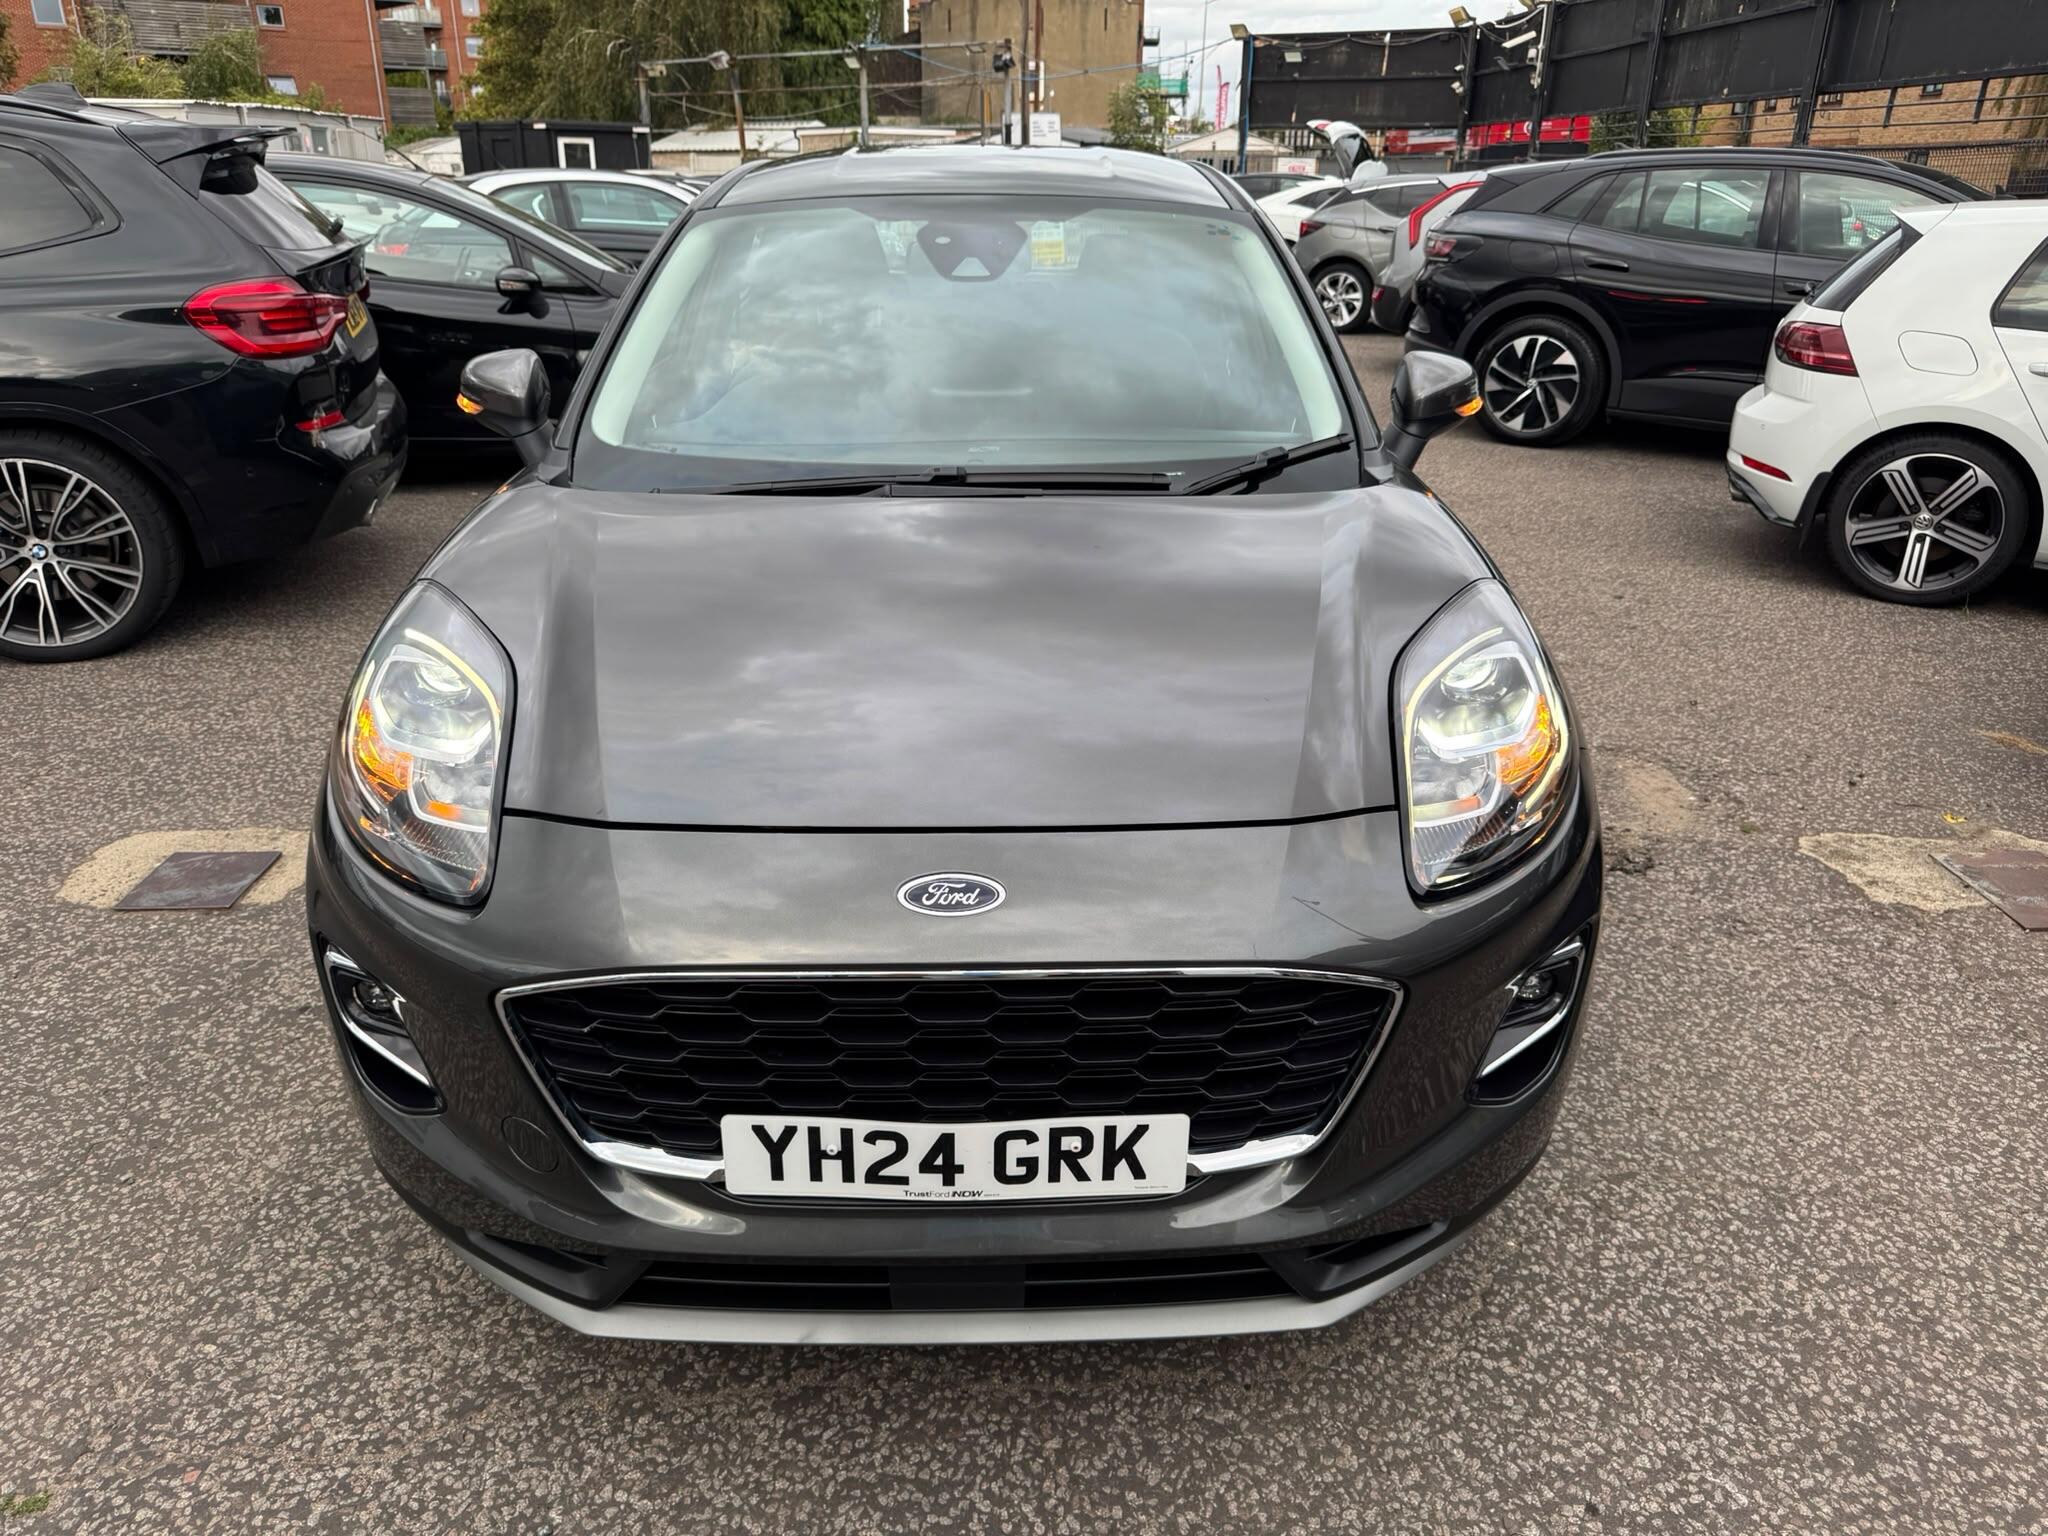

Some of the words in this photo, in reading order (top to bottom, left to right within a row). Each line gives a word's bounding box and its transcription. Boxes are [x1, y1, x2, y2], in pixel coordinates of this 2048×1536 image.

[921, 882, 980, 906] Ford
[751, 1124, 965, 1187] YH24
[993, 1124, 1150, 1185] GRK
[903, 1189, 950, 1198] TrustFord
[951, 1189, 984, 1198] NOW
